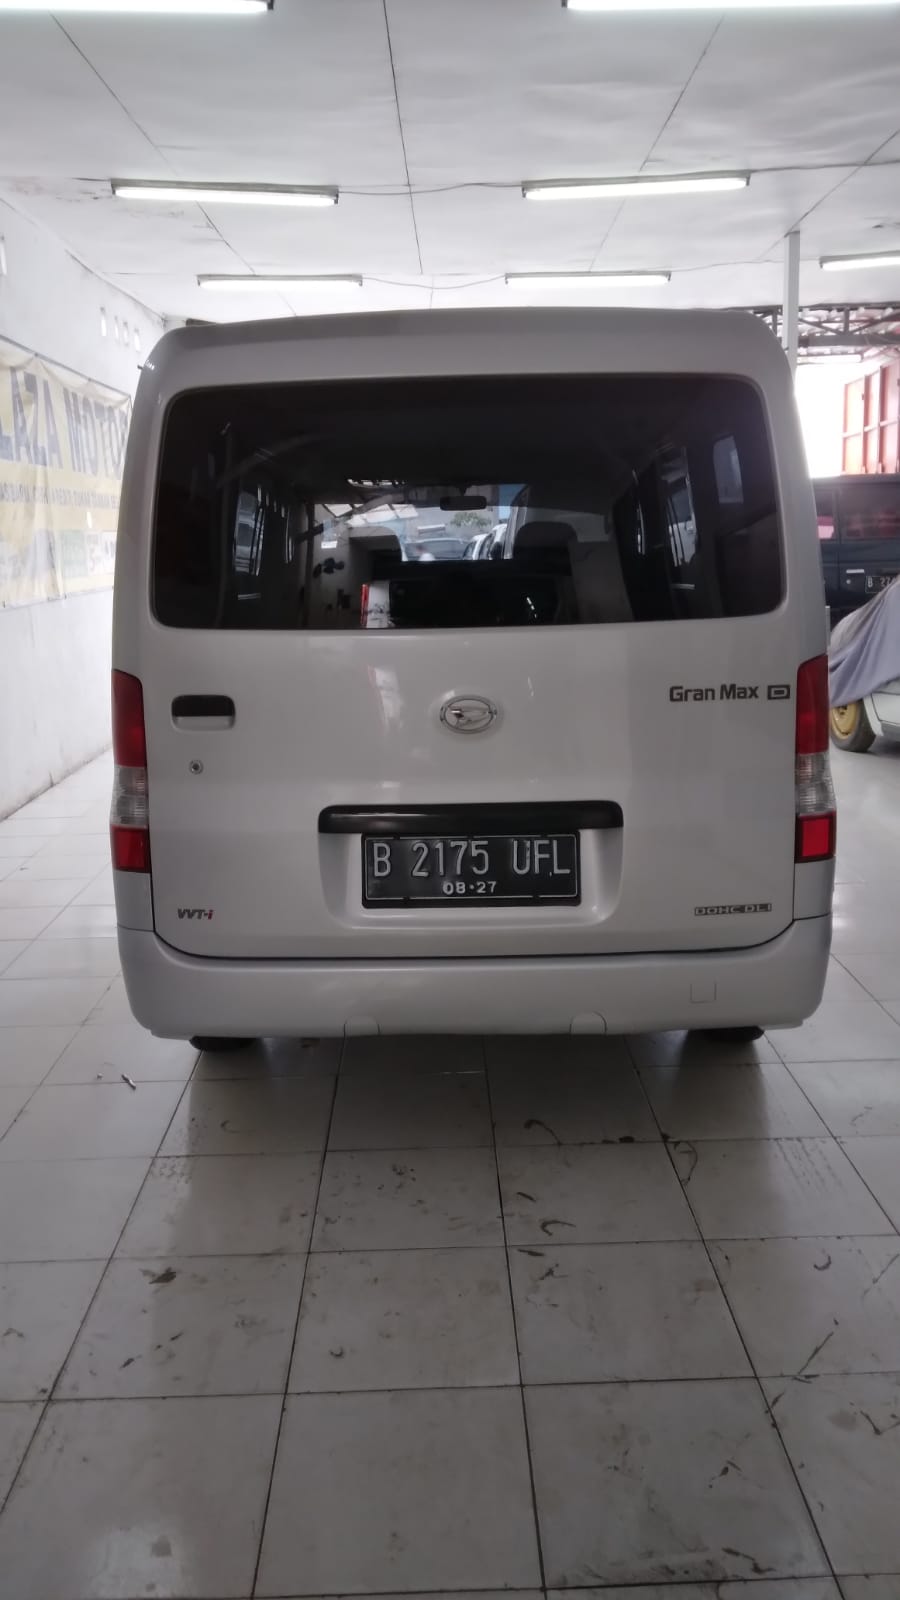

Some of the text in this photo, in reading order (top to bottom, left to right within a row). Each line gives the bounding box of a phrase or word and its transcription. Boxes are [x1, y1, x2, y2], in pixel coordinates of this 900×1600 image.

[669, 686, 715, 702] Gran
[720, 684, 759, 700] Max
[373, 839, 571, 877] B 2175 UFL
[177, 908, 213, 919] VVT-i
[695, 905, 741, 915] DOHC
